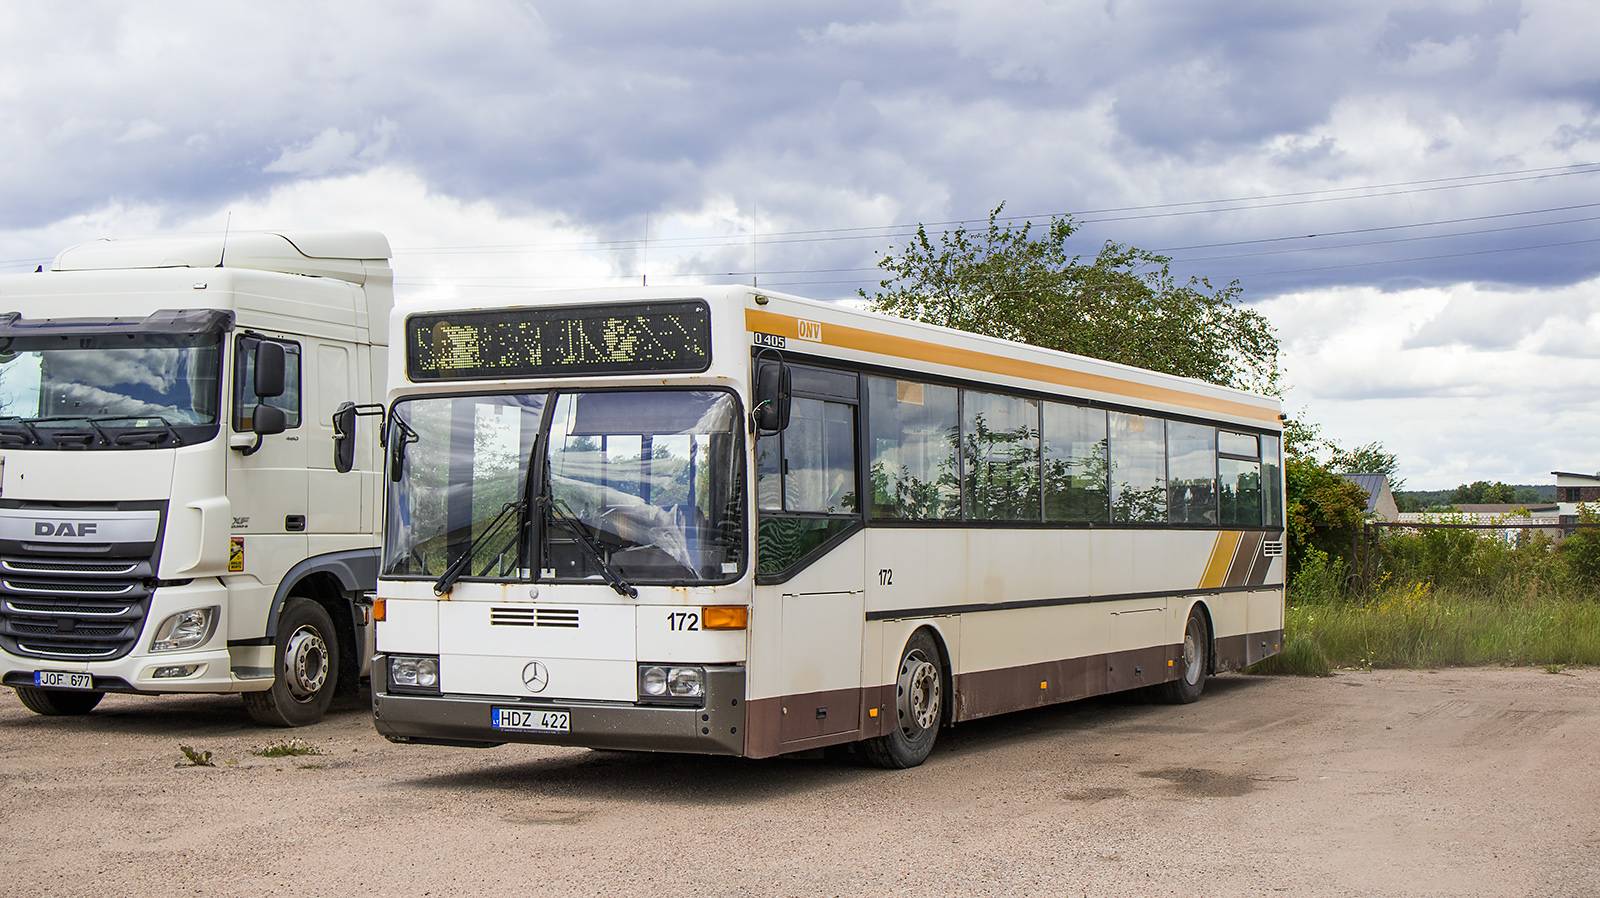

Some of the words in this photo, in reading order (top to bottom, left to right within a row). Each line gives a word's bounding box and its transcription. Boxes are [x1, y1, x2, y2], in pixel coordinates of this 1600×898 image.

[799, 320, 821, 339] ONV
[764, 335, 785, 348] 405
[34, 521, 97, 537] DAF
[878, 568, 893, 586] 172
[667, 612, 699, 631] 172
[41, 673, 64, 686] JOF
[71, 675, 90, 688] 677
[501, 710, 532, 727] HDZ
[541, 712, 568, 730] 422
